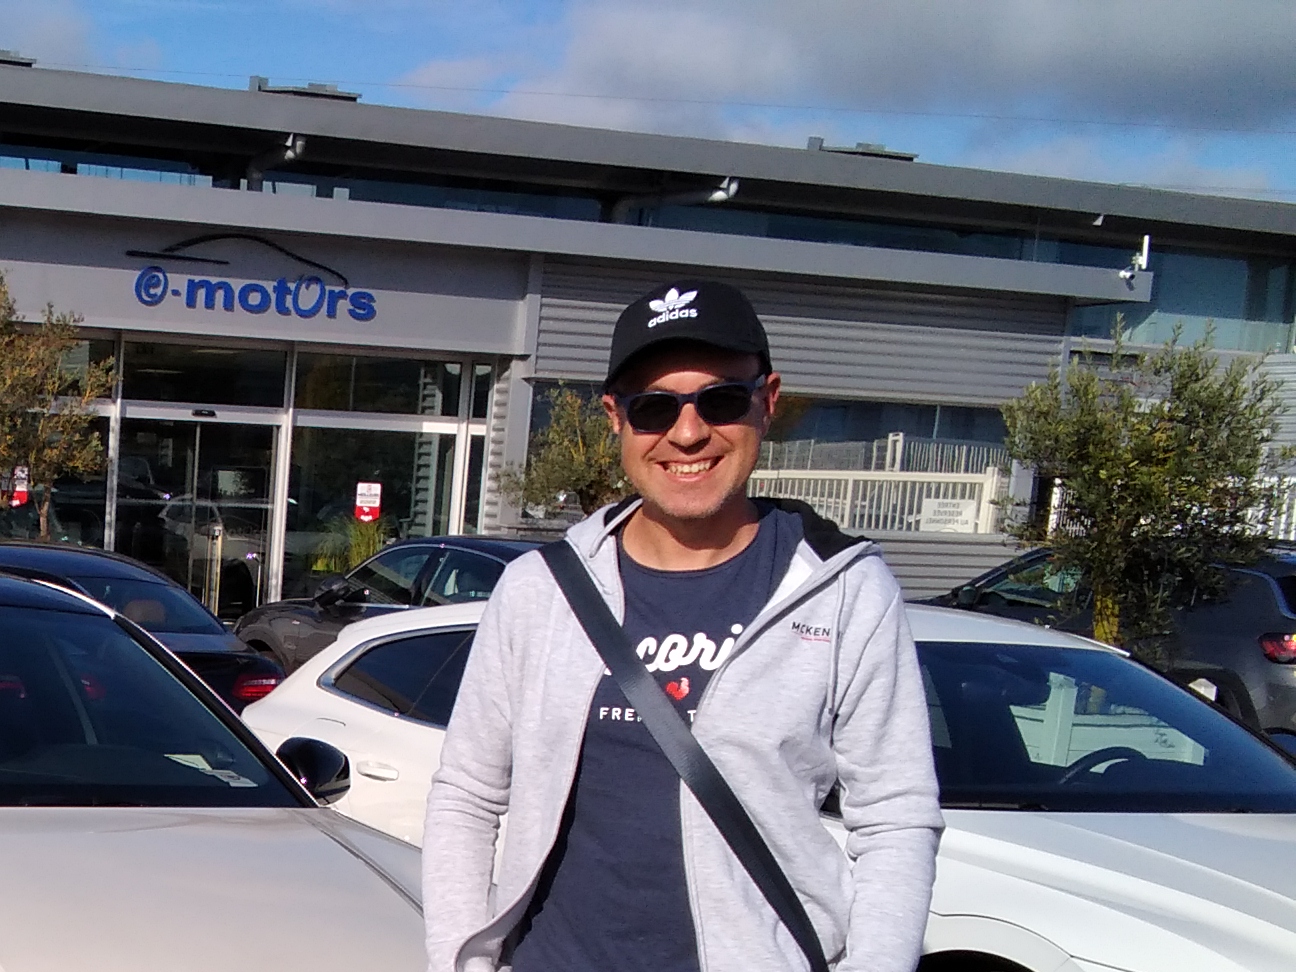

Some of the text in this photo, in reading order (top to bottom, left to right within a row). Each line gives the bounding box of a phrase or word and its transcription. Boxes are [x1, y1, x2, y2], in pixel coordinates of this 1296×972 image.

[647, 308, 698, 328] adidas
[791, 621, 831, 637] MCKEN
[636, 624, 744, 672] cori
[599, 707, 636, 721] FRE
